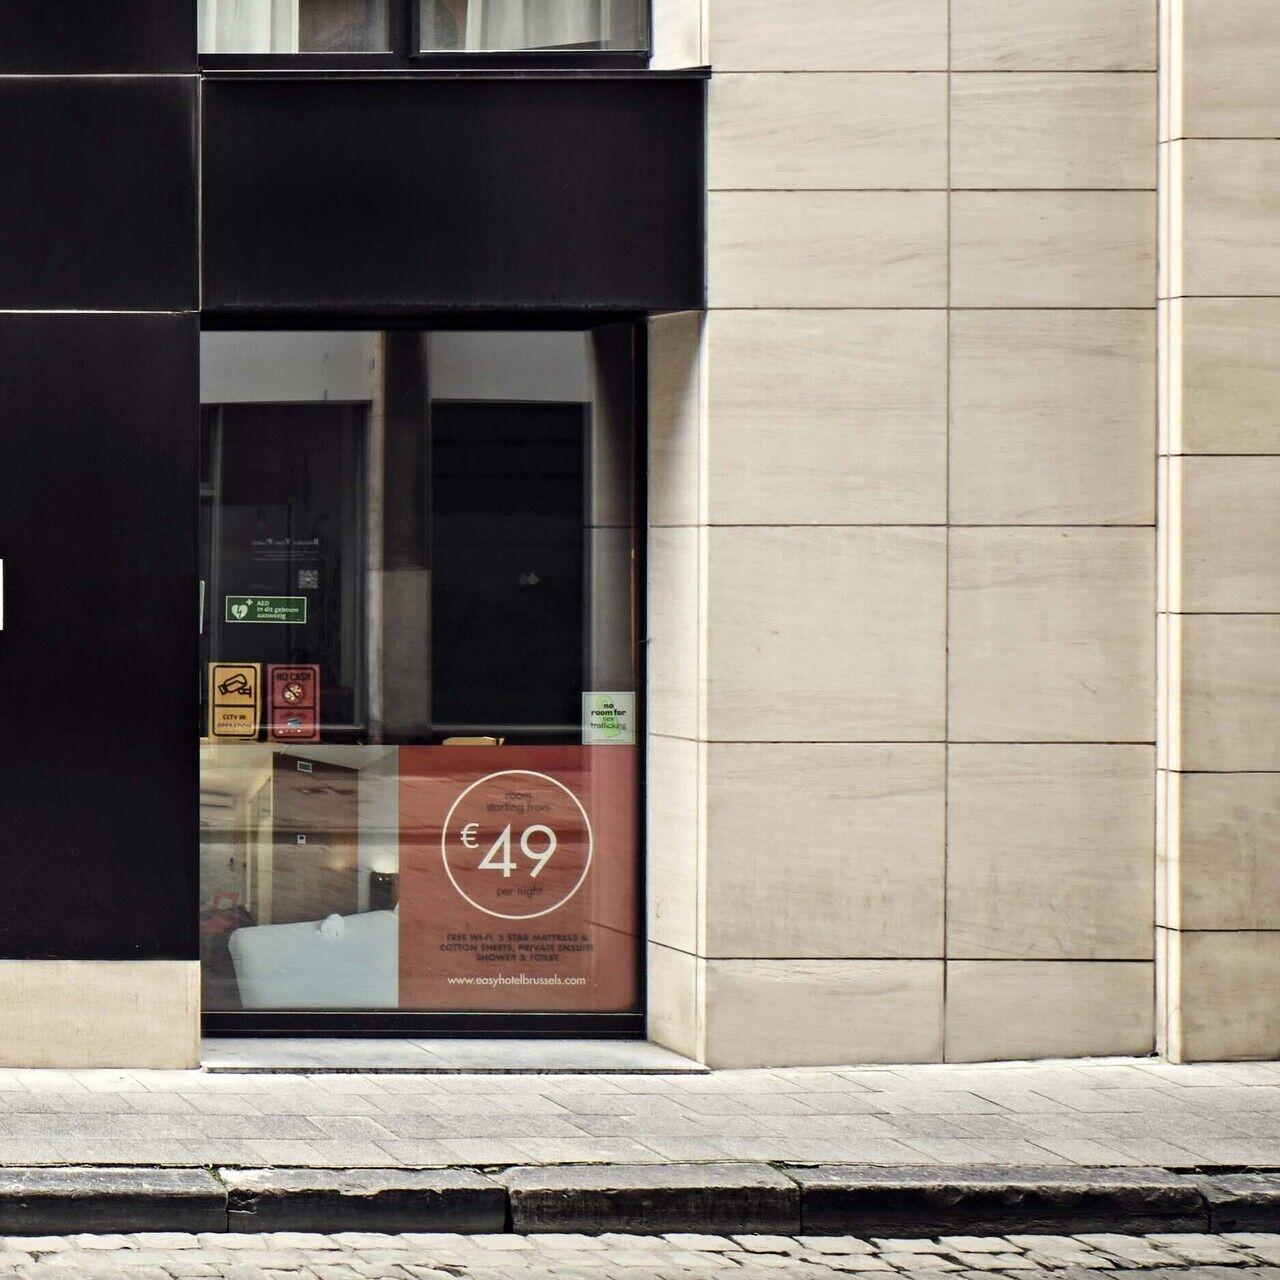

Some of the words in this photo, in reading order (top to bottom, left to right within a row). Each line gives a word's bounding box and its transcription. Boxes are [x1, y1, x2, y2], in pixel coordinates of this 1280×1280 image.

[276, 672, 288, 681] NO
[289, 672, 311, 681] CASH
[486, 803, 524, 814] starting
[527, 802, 551, 812] from
[496, 887, 514, 897] per
[517, 885, 544, 899] night
[440, 944, 478, 952] COTTON
[447, 974, 586, 988] www.easyhotelbrussels.com
